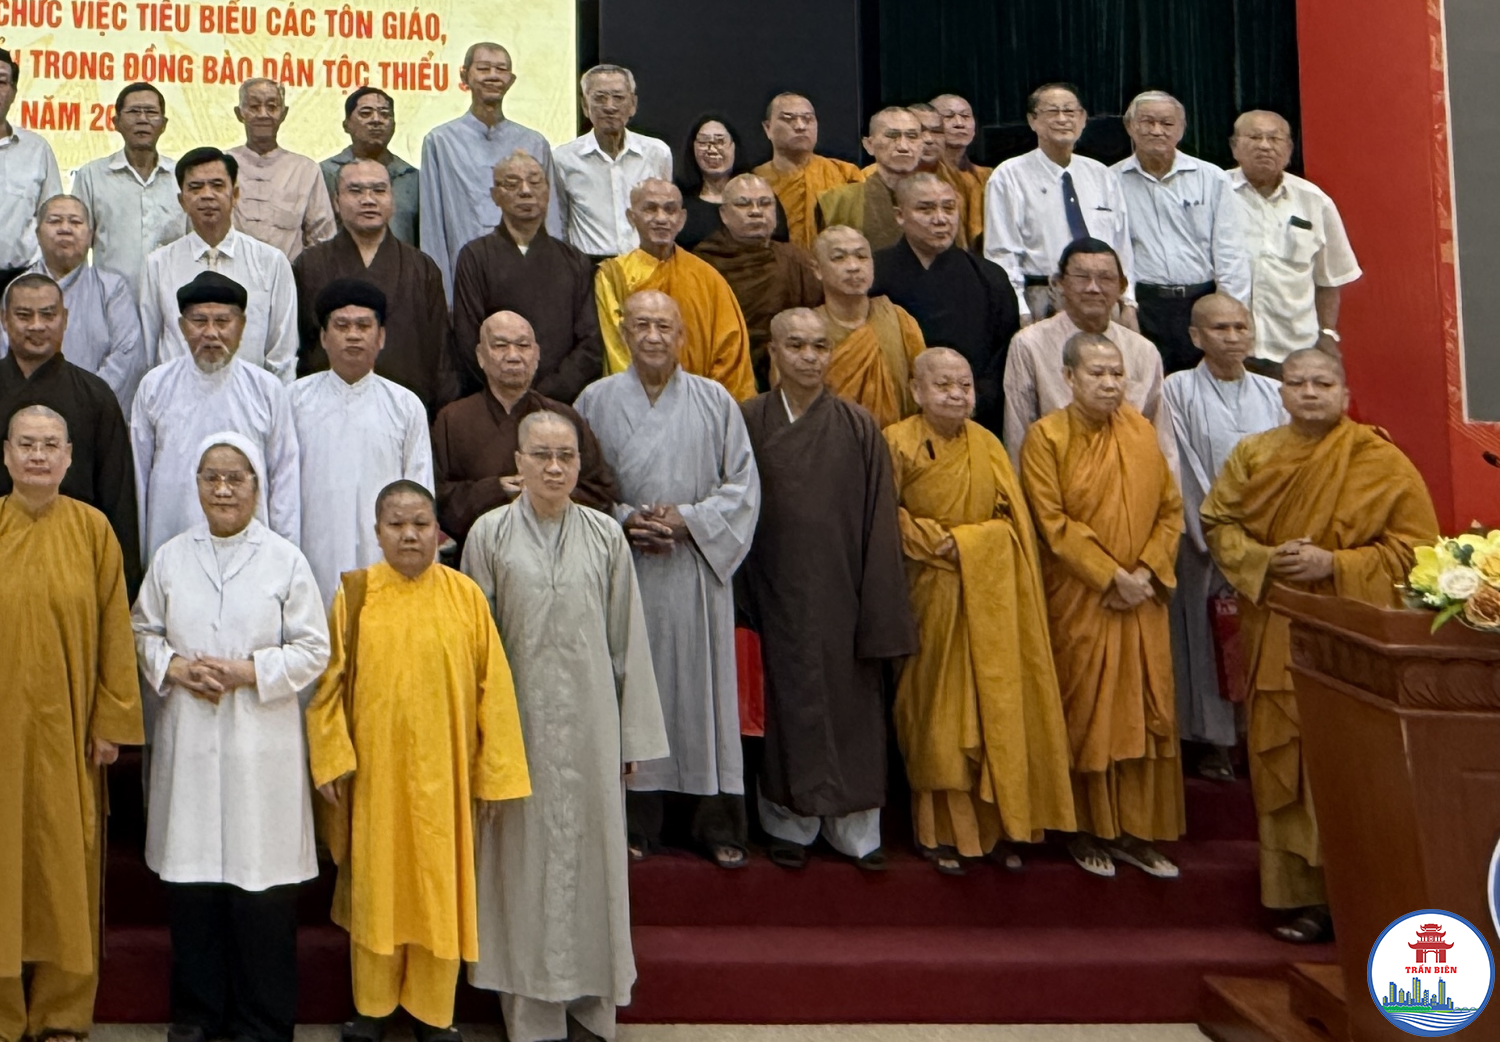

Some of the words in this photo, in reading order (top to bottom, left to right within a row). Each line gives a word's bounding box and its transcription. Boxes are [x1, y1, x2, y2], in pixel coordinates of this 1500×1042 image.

[266, 2, 316, 38] CÁC
[324, 4, 373, 39] TÔN
[382, 6, 447, 45] GIÁO,
[30, 49, 114, 81] TRONG
[124, 43, 193, 84] ĐỒNG
[202, 49, 253, 85] BÀO
[263, 52, 314, 87] DÂN
[323, 54, 370, 95] TỘC
[378, 49, 449, 91] THIỂU
[21, 95, 80, 131] NĂM
